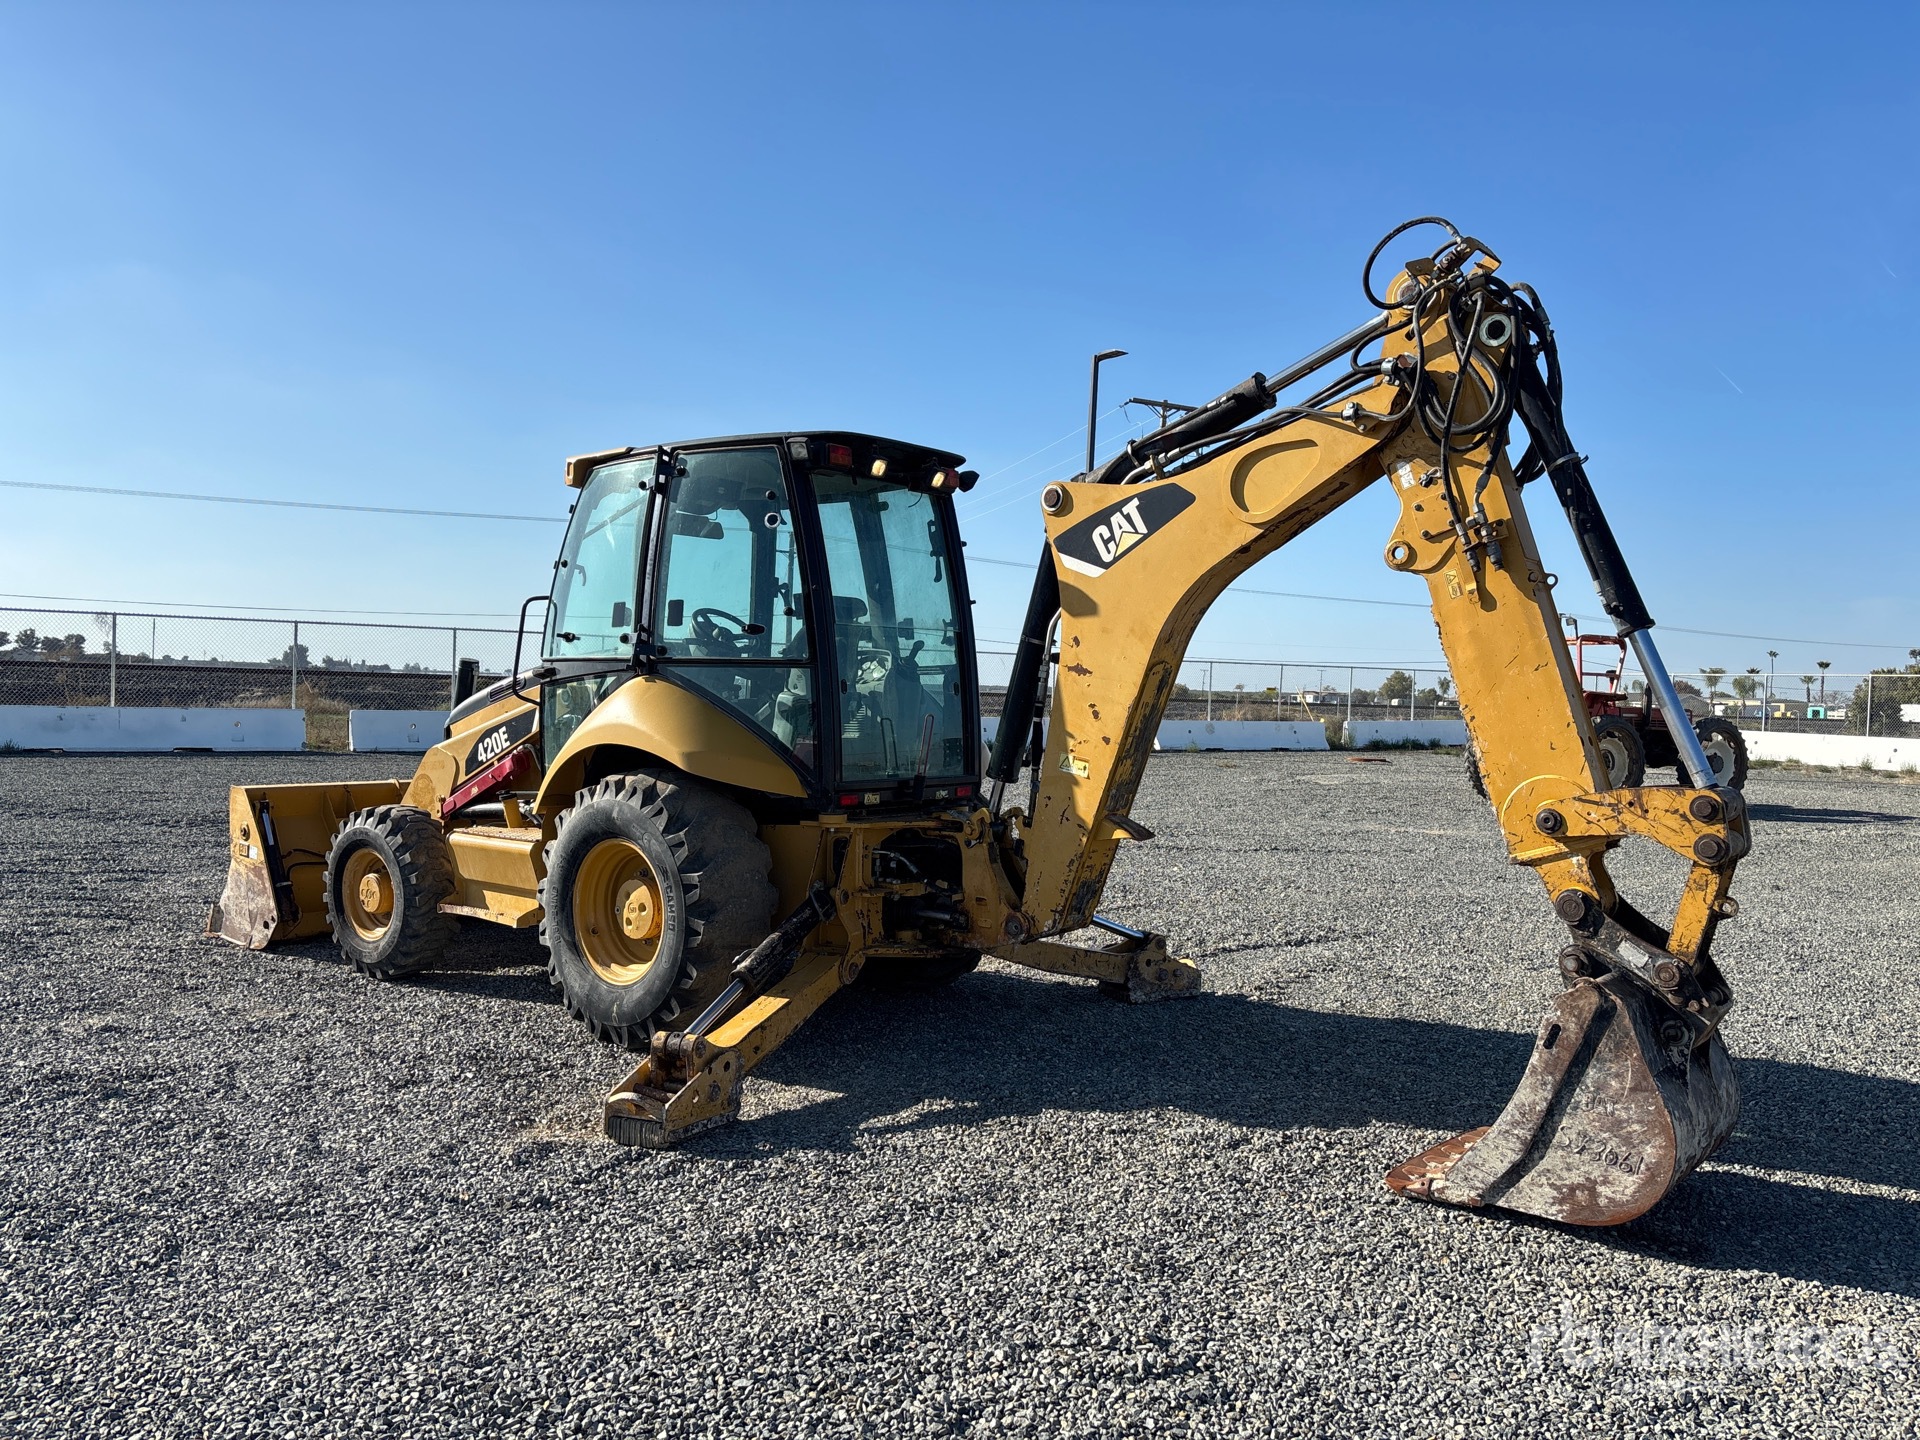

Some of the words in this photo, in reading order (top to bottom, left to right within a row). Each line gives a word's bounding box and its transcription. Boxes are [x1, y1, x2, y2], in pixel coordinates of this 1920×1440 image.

[1092, 497, 1148, 563] CAT
[477, 726, 511, 763] 420E
[665, 884, 676, 932] CAMSO
